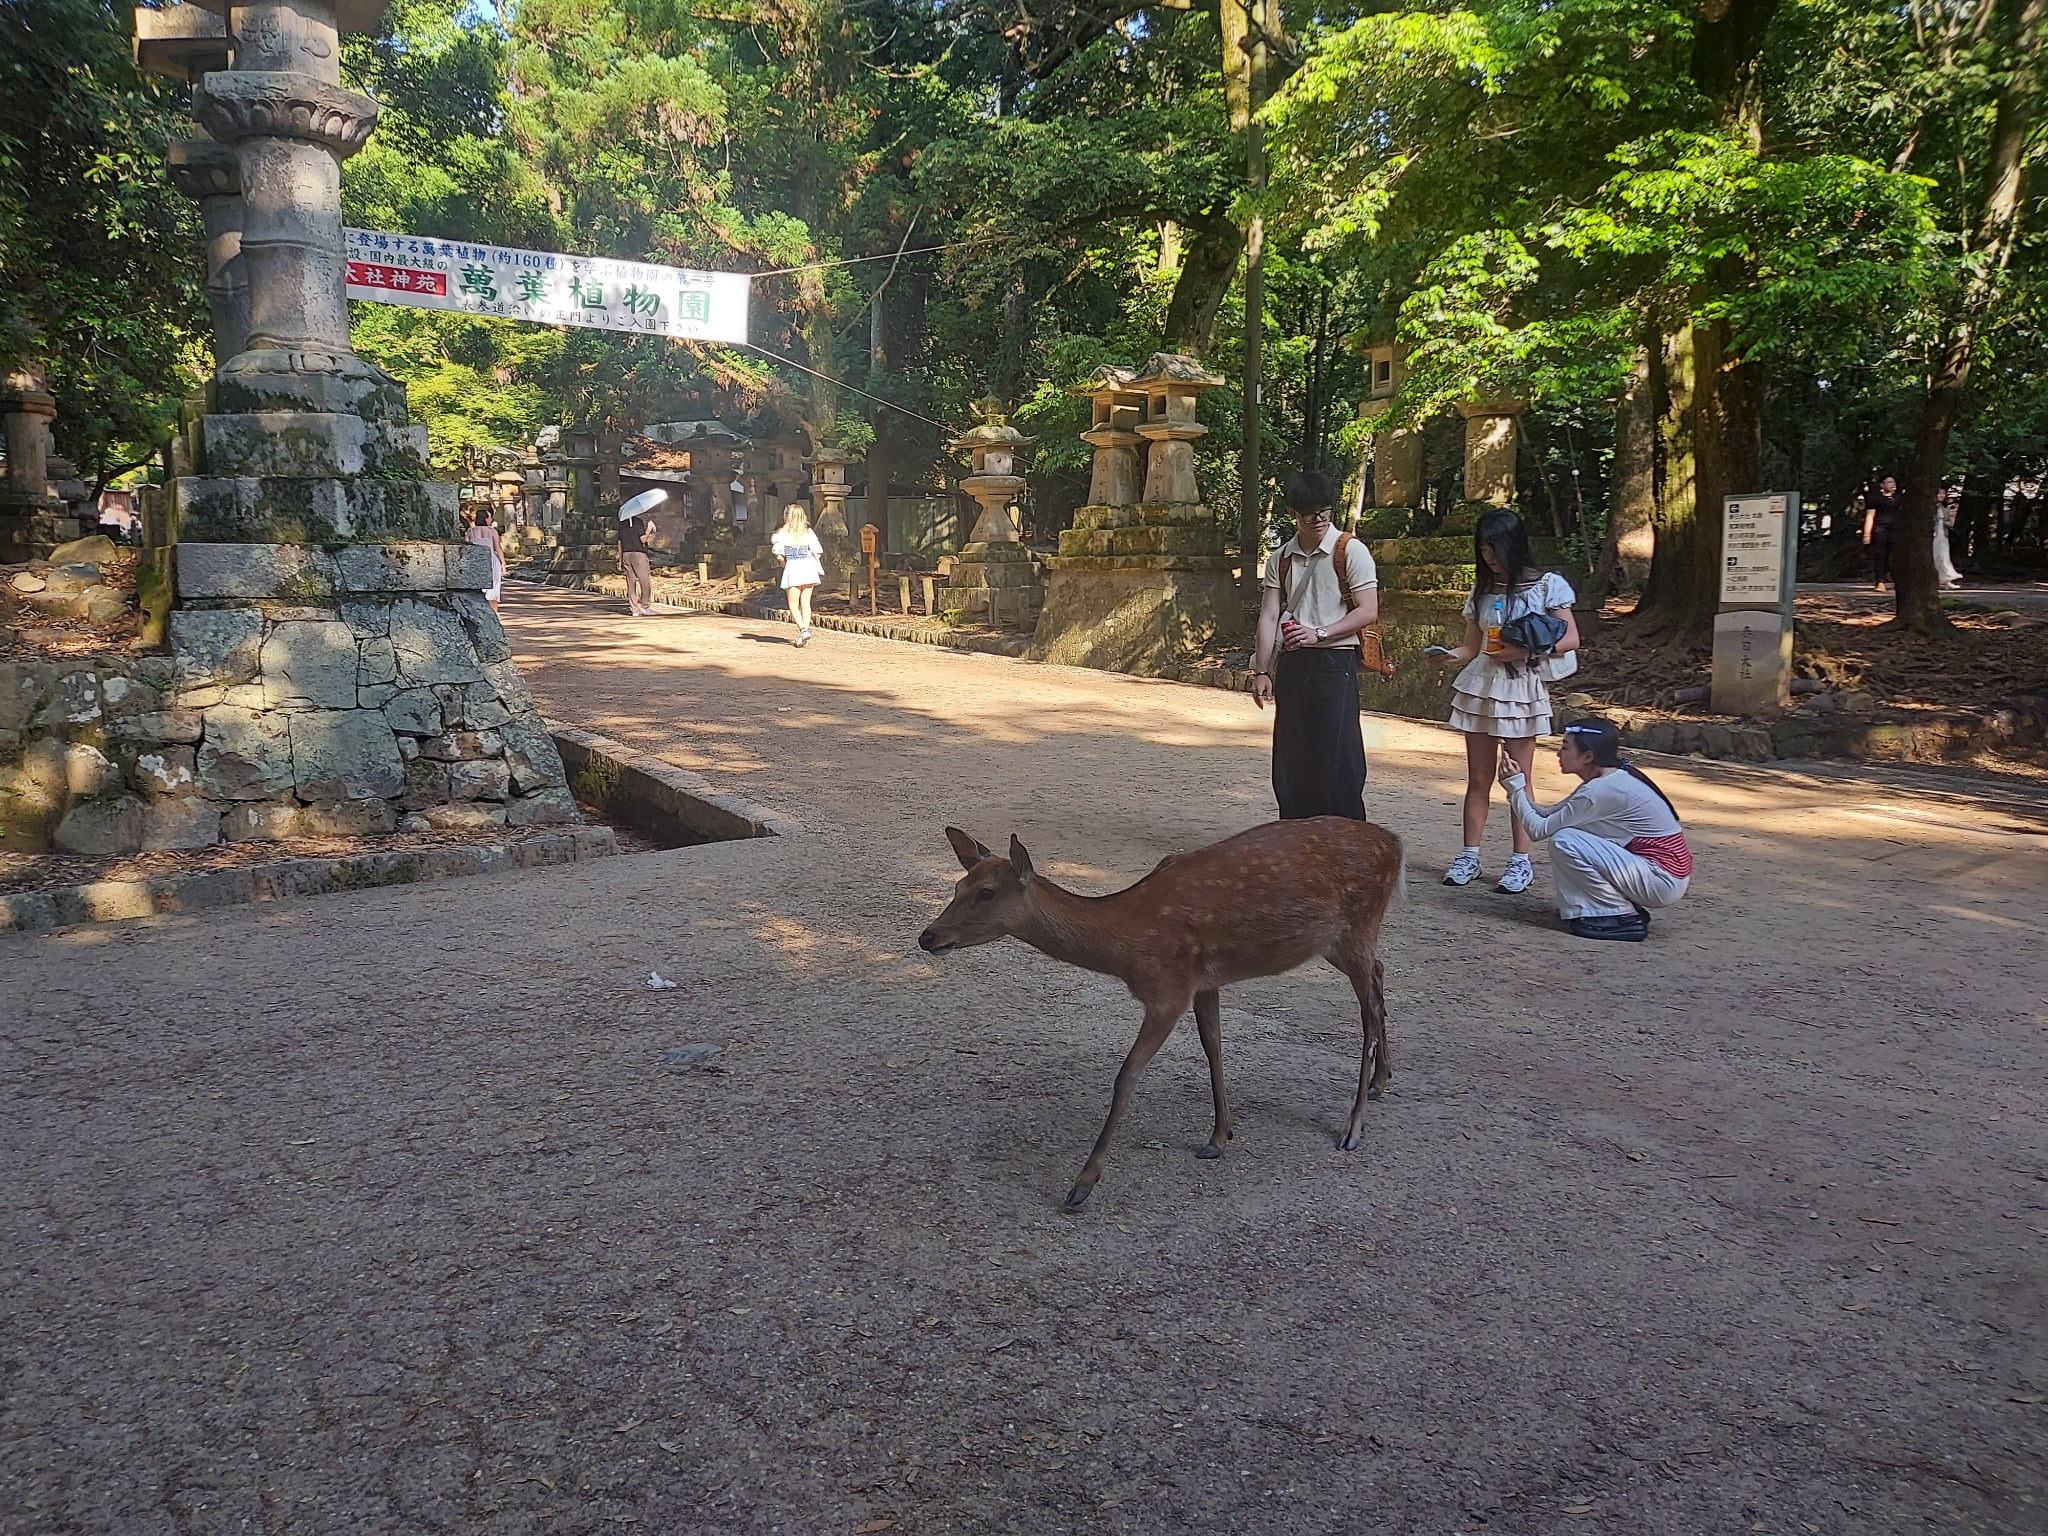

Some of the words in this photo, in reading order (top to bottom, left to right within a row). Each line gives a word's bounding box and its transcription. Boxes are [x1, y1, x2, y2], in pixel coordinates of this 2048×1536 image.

[460, 263, 711, 324] 萬葉植物園
